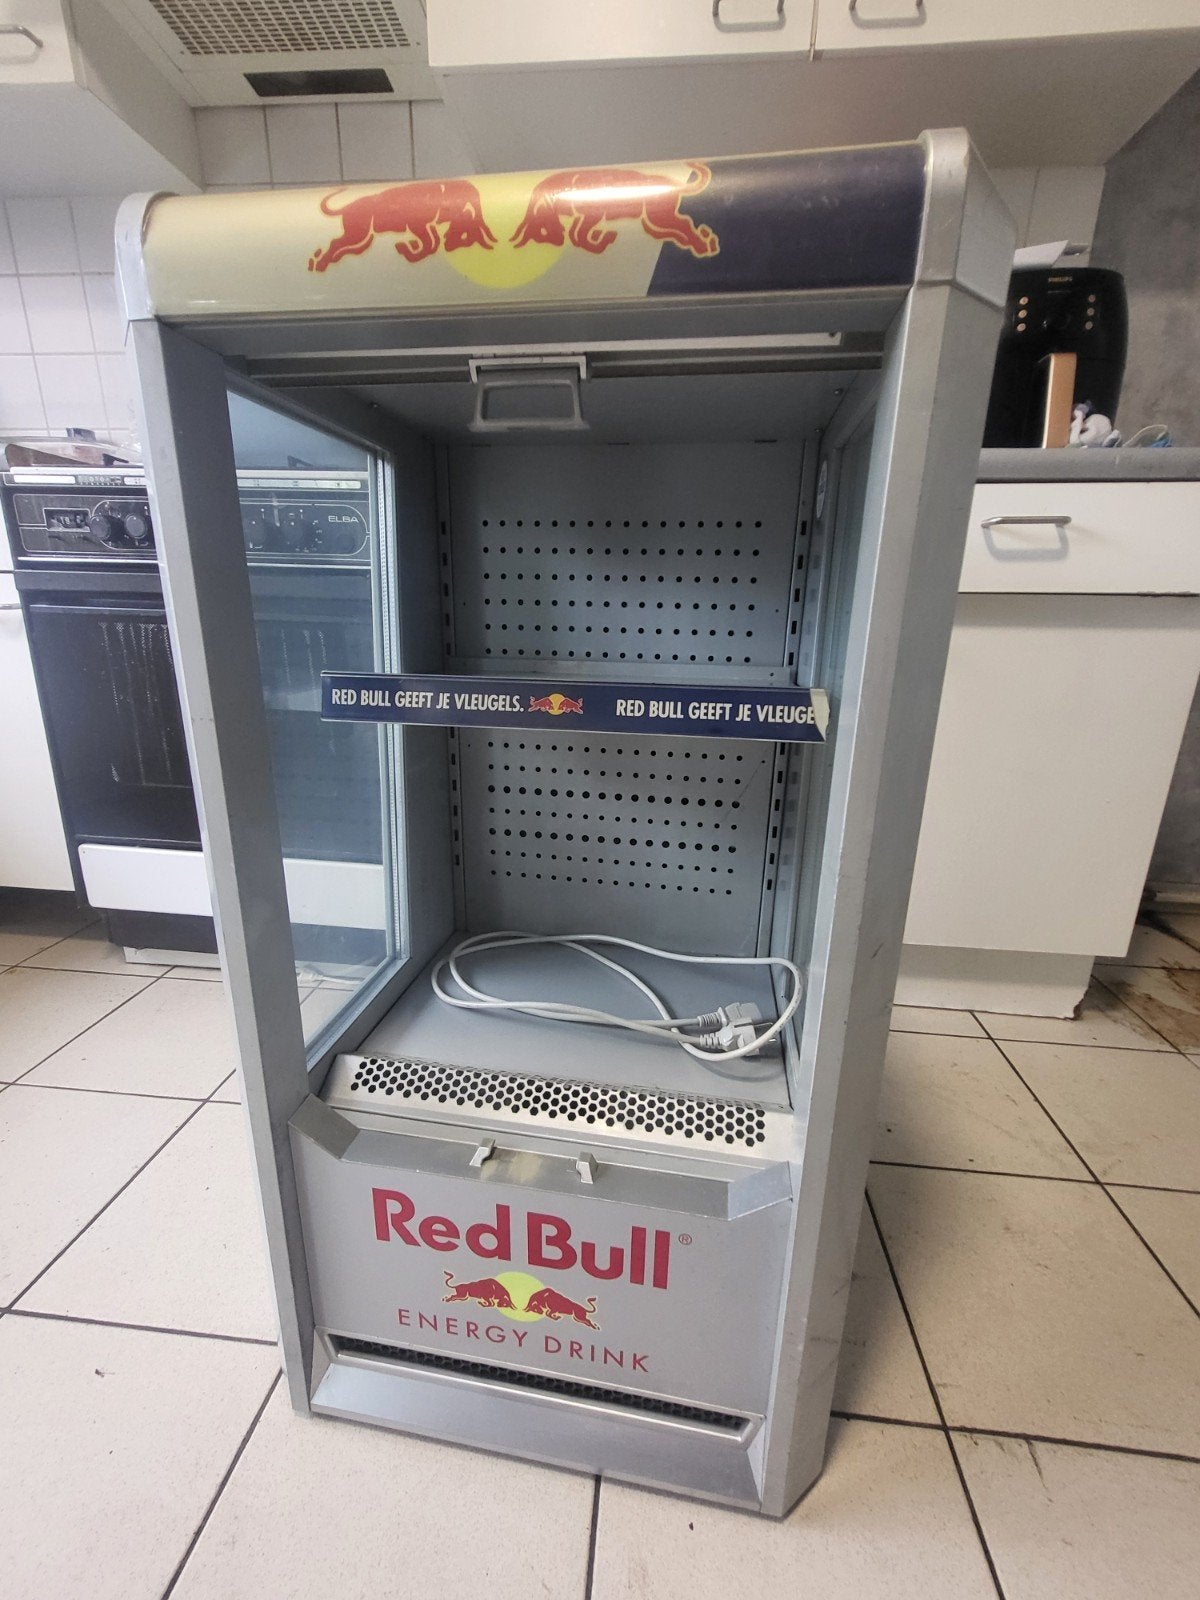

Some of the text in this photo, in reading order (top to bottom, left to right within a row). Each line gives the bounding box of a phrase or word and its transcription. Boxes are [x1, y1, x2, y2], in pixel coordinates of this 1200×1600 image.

[328, 515, 359, 523] ELBA
[332, 688, 524, 712] RED BULL GEEFT JE VLEUGELS.
[616, 699, 645, 717] RED
[649, 700, 684, 719] BULL
[688, 702, 733, 721] GEEFT
[735, 704, 751, 722] JE
[371, 1187, 512, 1262] Red
[526, 1211, 670, 1290] Bull
[397, 1308, 649, 1373] ENERGY DRINK
